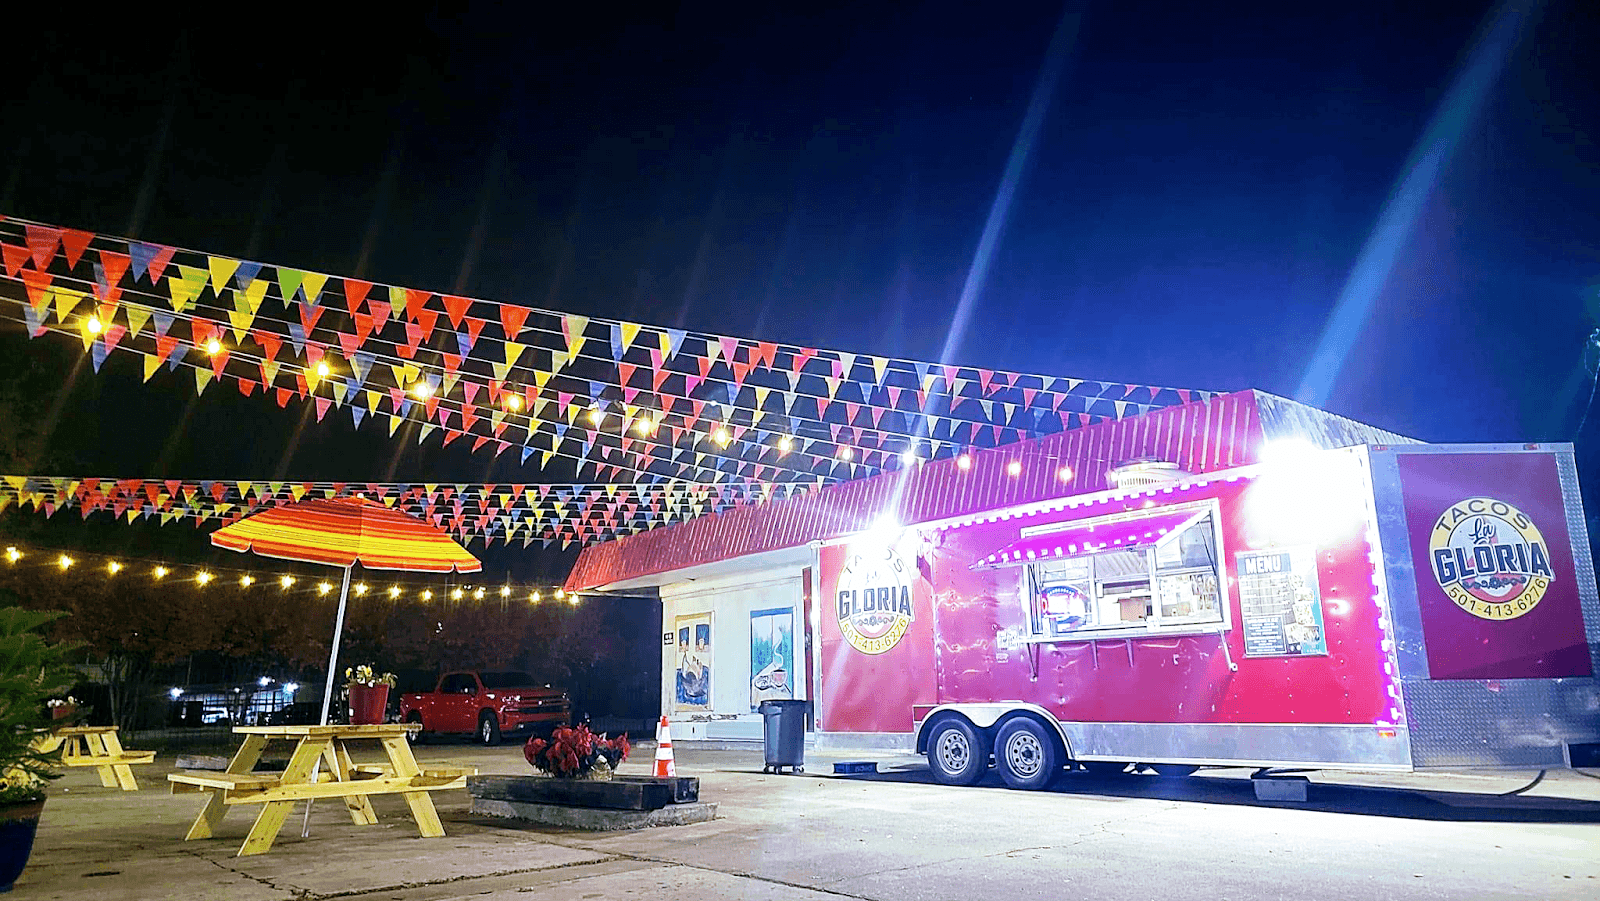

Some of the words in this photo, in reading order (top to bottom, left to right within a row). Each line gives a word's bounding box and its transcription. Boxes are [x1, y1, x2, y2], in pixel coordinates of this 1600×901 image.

[1436, 500, 1530, 532] TACOS
[1468, 517, 1496, 543] La
[1244, 554, 1281, 575] MENU
[1434, 542, 1552, 584] GLORIA
[839, 586, 911, 620] GLORIA
[1449, 578, 1546, 617] 501-413-6276
[842, 617, 907, 650] 501-413-6276
